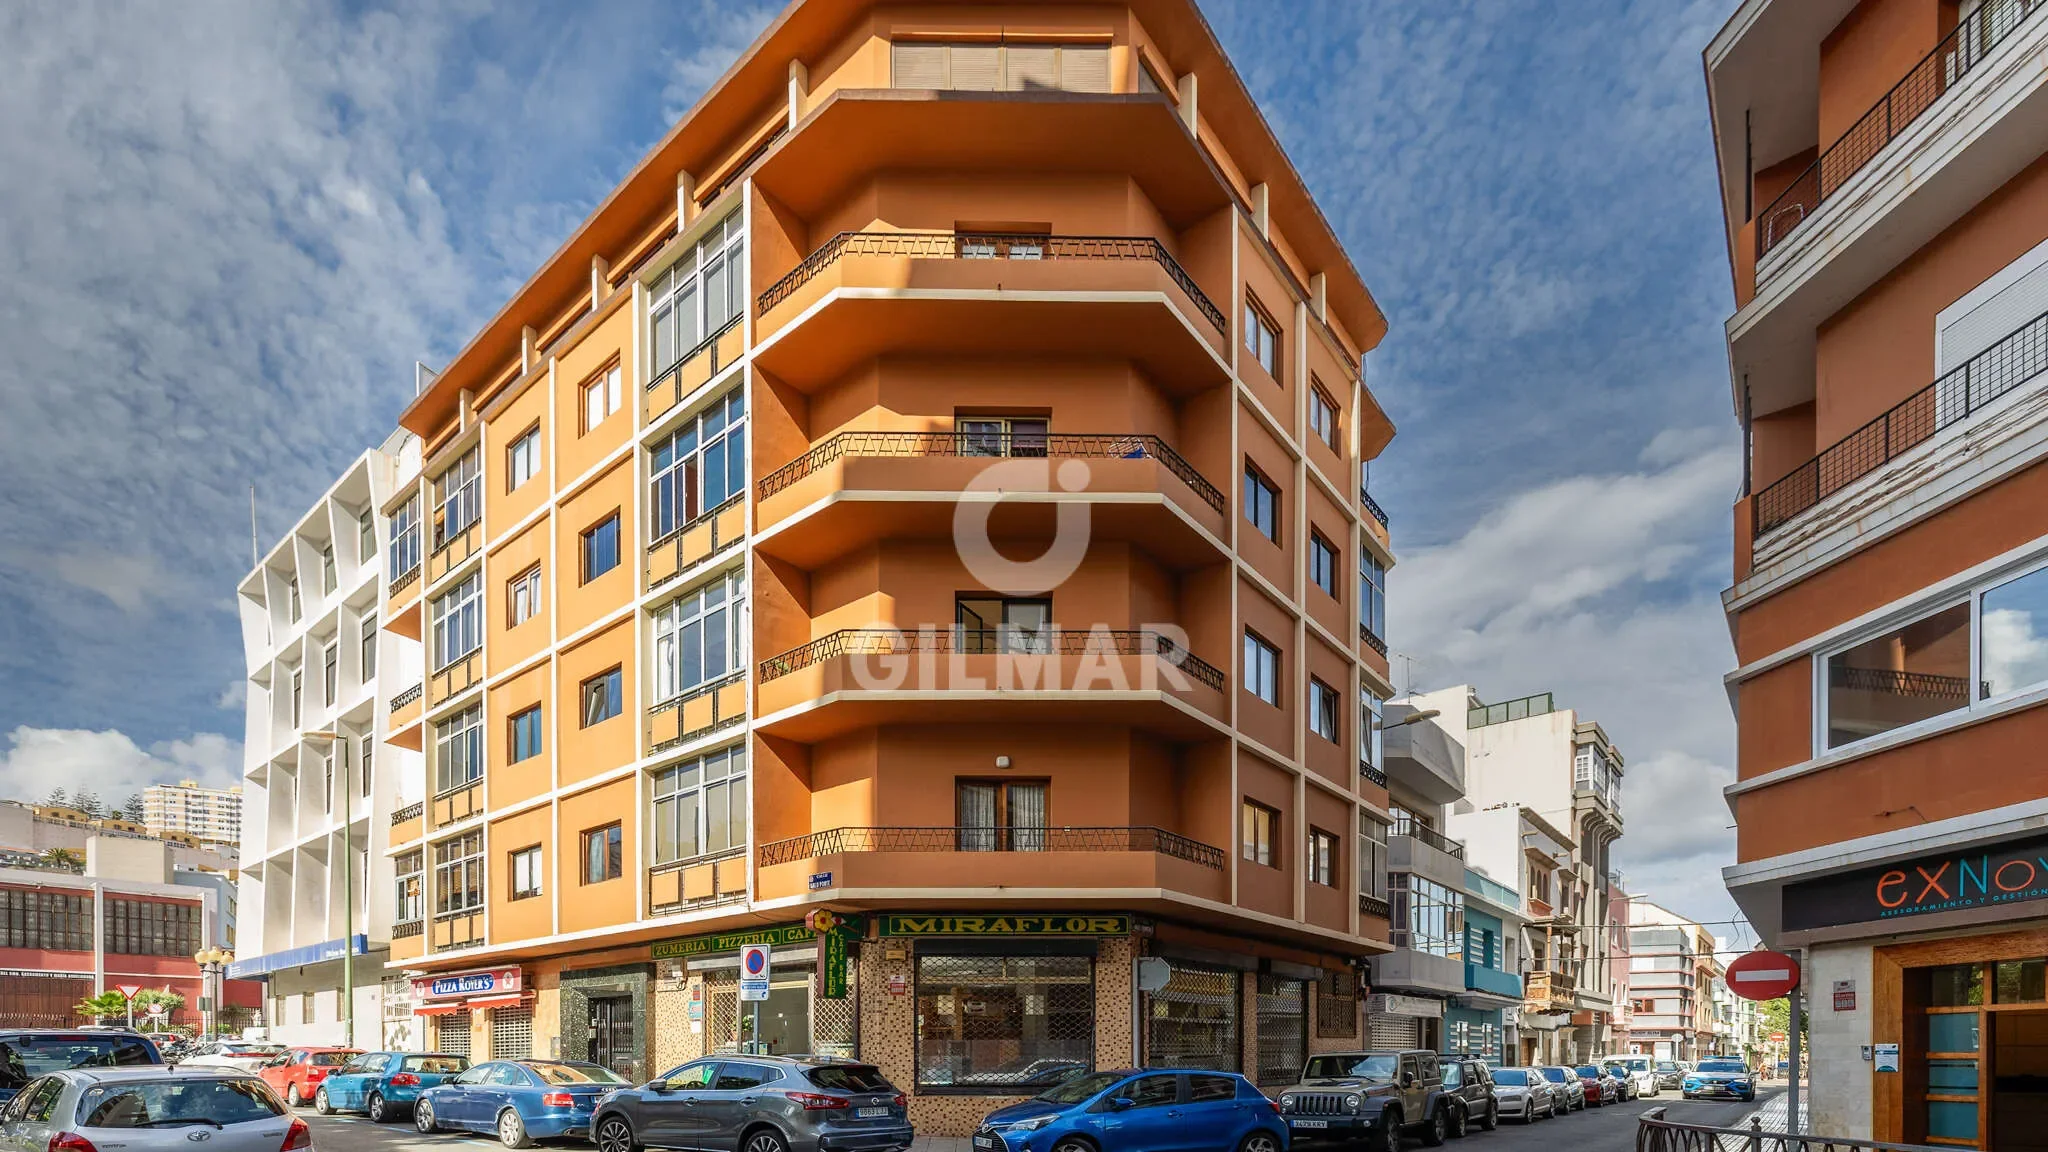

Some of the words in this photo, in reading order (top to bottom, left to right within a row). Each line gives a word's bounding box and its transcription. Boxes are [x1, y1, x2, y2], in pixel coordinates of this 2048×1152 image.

[1880, 899, 1973, 917] ASESORAMIENTO
[899, 917, 1121, 932] MIRAFLOR
[655, 941, 706, 956] ZUMERIA
[718, 933, 775, 949] PIZZERIA
[828, 927, 838, 996] MIRAFLOR
[435, 981, 457, 994] PIZZA
